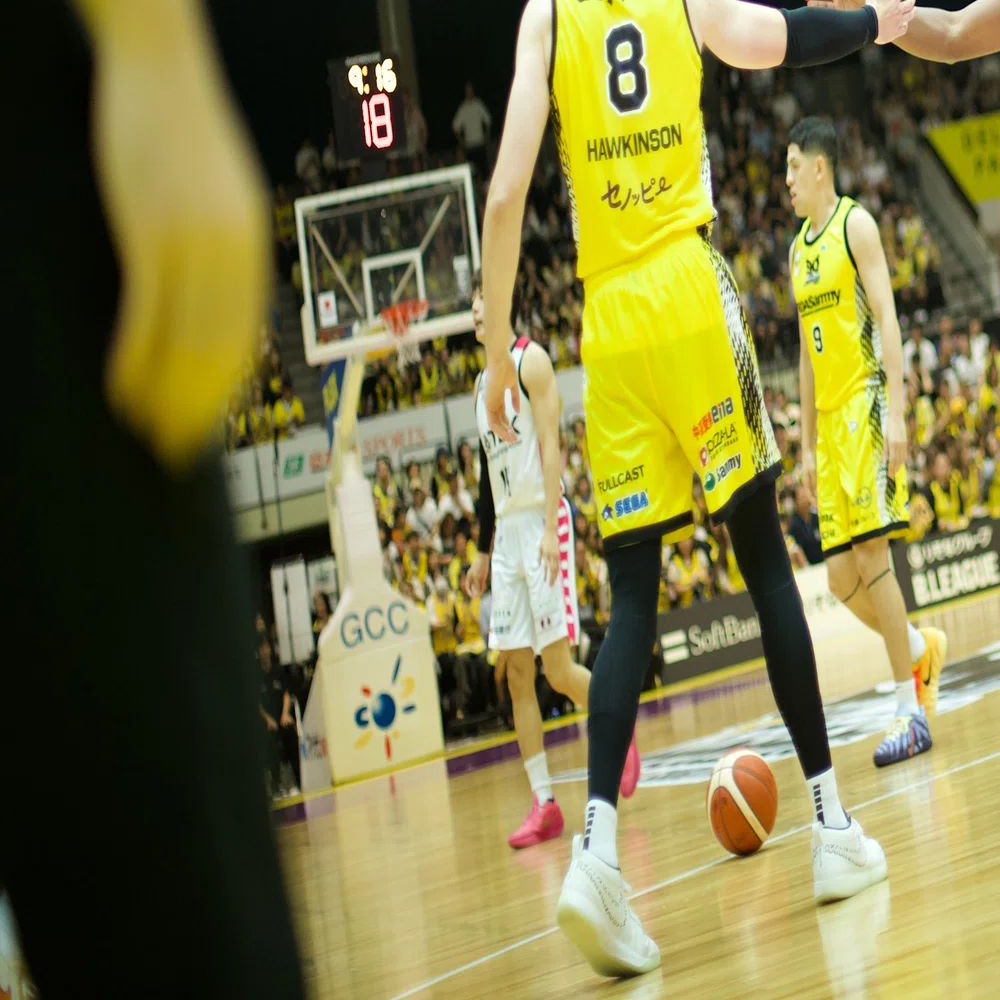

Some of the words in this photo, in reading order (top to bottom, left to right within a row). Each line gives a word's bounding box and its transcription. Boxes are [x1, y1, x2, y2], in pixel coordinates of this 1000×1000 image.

[604, 20, 649, 116] 8
[362, 93, 393, 149] 18
[587, 123, 682, 162] HAWKINSON
[813, 326, 823, 353] 9
[597, 464, 645, 493] FULLCAST
[614, 491, 649, 518] SEGA
[340, 601, 409, 648] GCC
